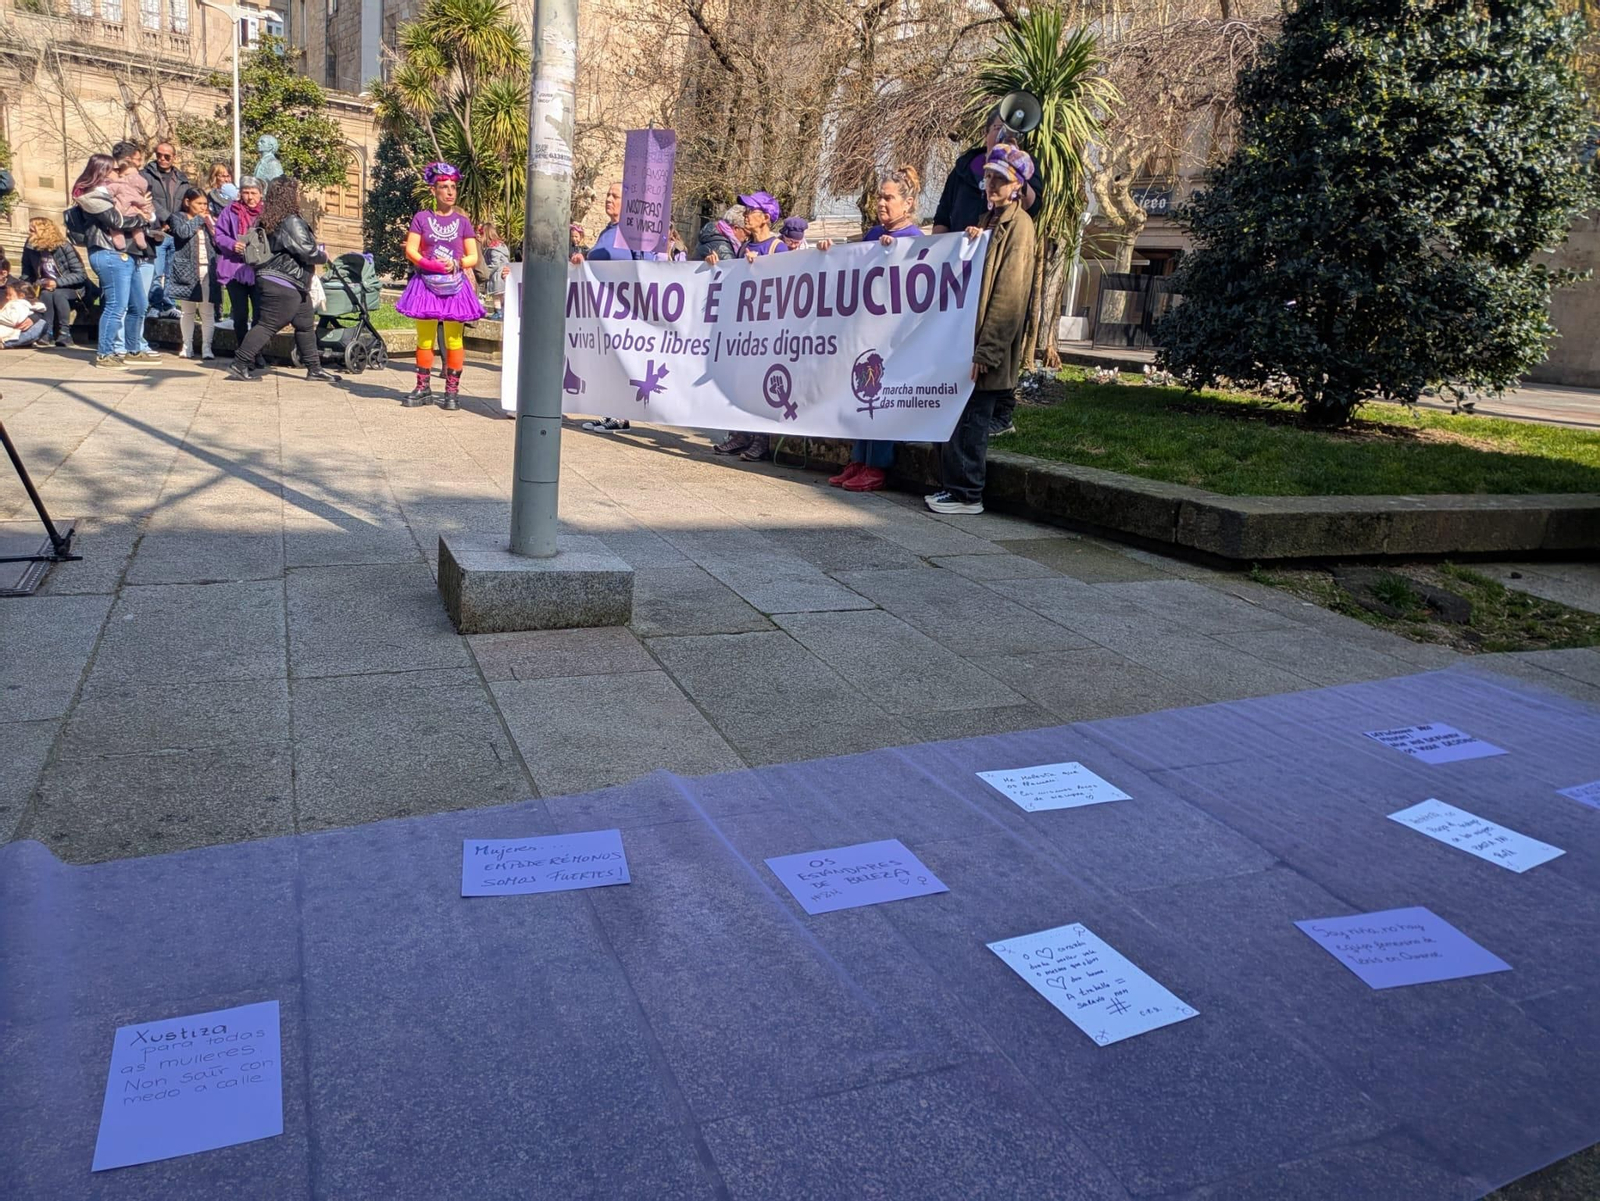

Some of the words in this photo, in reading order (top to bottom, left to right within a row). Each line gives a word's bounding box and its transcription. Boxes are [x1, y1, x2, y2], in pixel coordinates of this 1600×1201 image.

[517, 281, 685, 323] MINISMO
[703, 270, 723, 323] É
[735, 248, 972, 323] REVOLUCIÓN
[568, 327, 595, 349] viva
[604, 328, 656, 356] pobos
[660, 330, 711, 356] libres
[726, 331, 769, 357] vidas
[773, 329, 838, 362] dignas
[882, 383, 913, 395] marcha
[915, 382, 958, 395] mundial
[880, 396, 895, 408] das
[896, 396, 941, 409] mulleres
[809, 858, 836, 868] OS
[130, 1024, 227, 1047] Xustiza
[141, 1041, 194, 1063] para
[206, 1029, 266, 1046] todas
[121, 1063, 147, 1075] as
[124, 1077, 167, 1093] Non
[240, 1059, 274, 1073] con
[123, 1088, 181, 1106] medo
[194, 1084, 208, 1093] a
